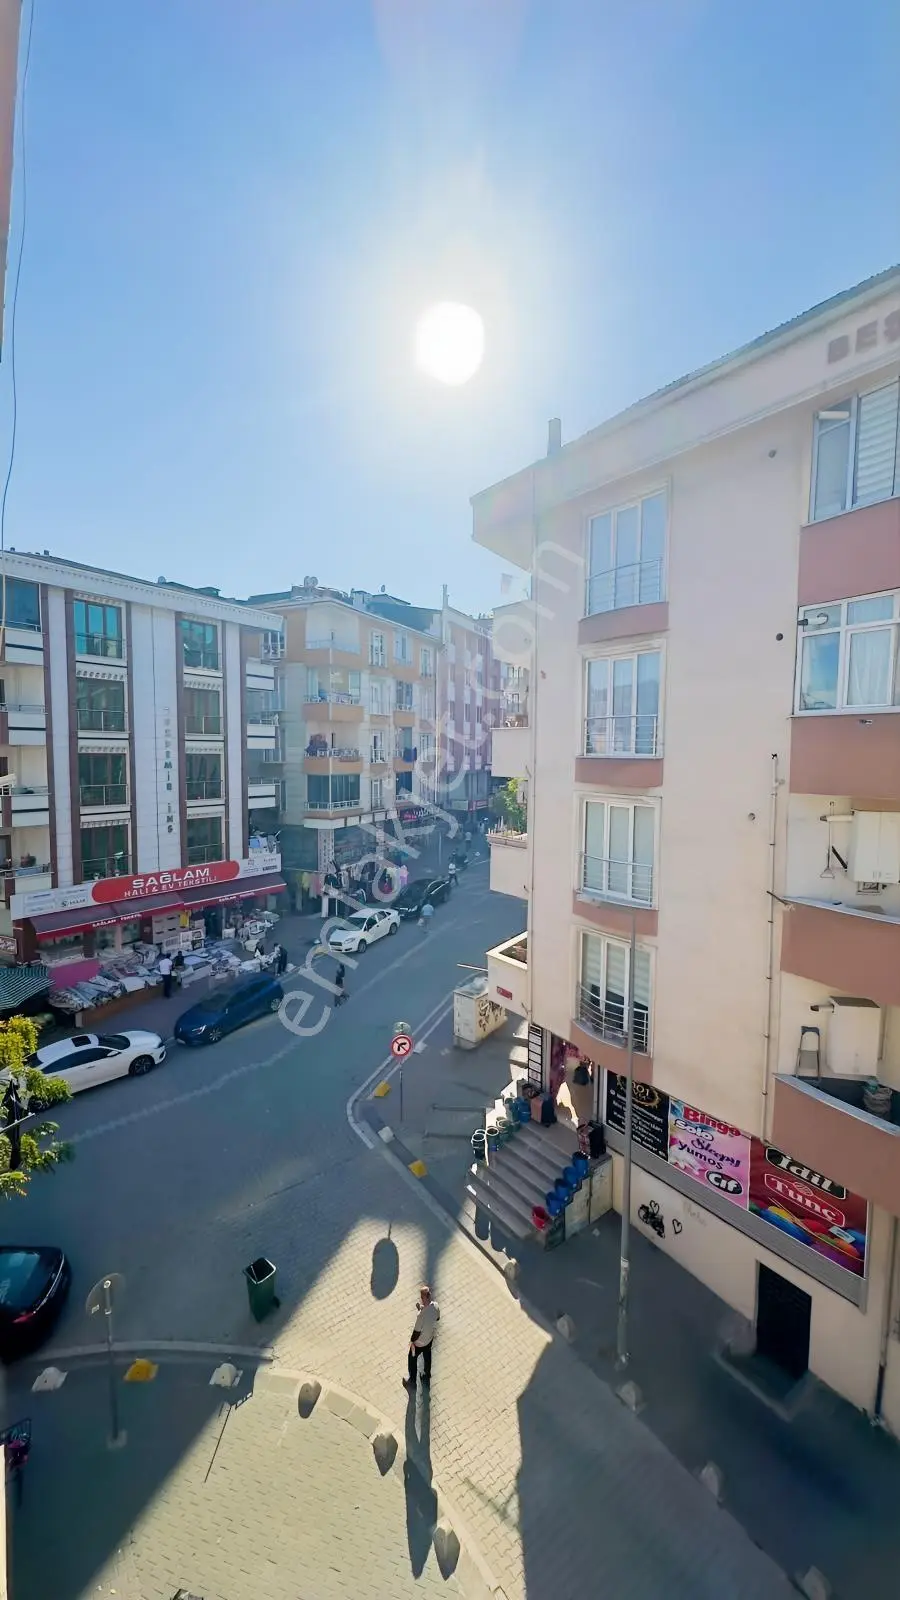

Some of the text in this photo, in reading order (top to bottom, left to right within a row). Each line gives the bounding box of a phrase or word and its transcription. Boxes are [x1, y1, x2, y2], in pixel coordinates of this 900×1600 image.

[132, 868, 210, 889] SAĞLAM
[674, 1119, 714, 1142] Solo
[683, 1106, 741, 1137] Bingo
[708, 1173, 738, 1192] Cif
